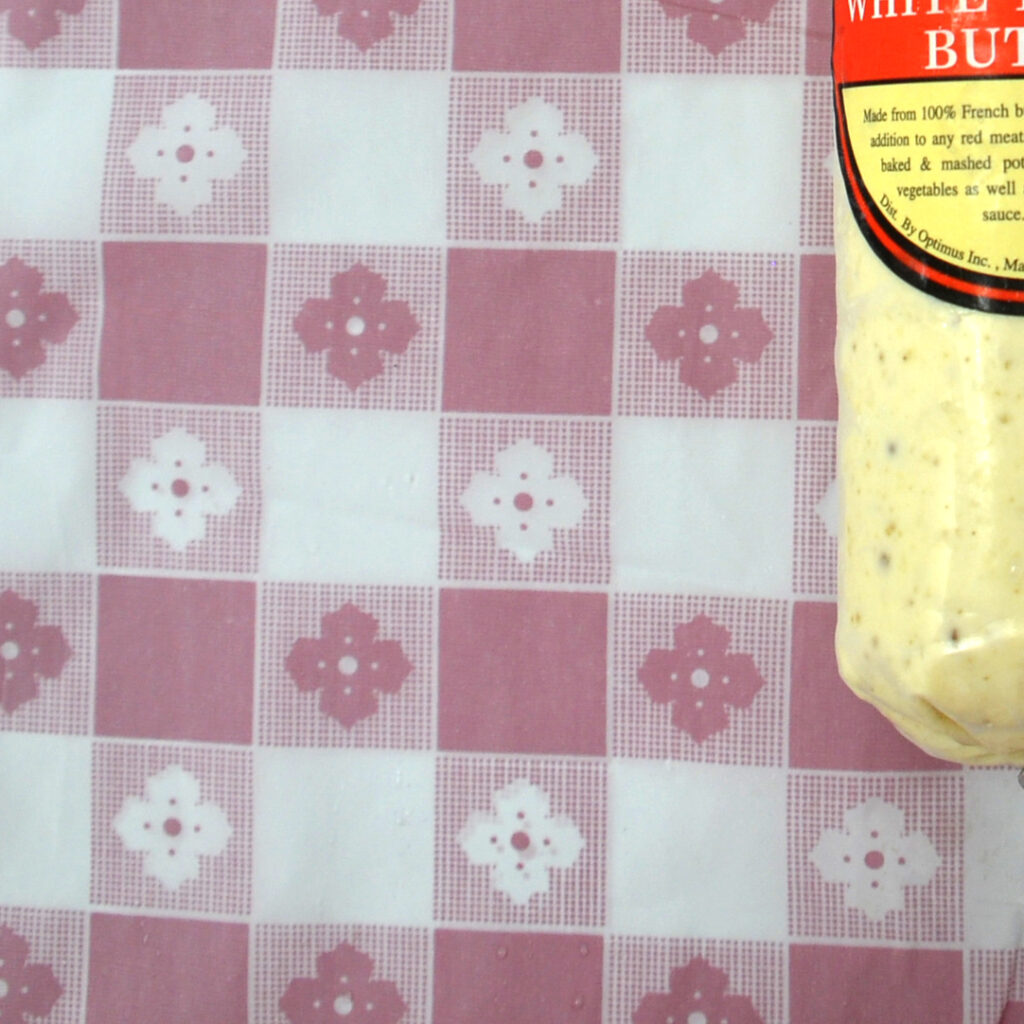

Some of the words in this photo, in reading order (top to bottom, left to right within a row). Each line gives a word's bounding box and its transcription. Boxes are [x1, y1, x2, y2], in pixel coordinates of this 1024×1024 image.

[863, 109, 887, 123] Made
[891, 108, 916, 122] from
[922, 105, 956, 120] 100%
[962, 104, 1009, 119] French
[870, 133, 910, 148] addition
[915, 133, 926, 145] to
[932, 132, 954, 148] any
[961, 130, 982, 145] red
[881, 157, 911, 172] baked
[921, 158, 931, 171] &
[941, 156, 992, 171] mashed
[897, 182, 958, 201] vegetables
[965, 184, 979, 196] as
[987, 180, 1015, 195] well
[982, 207, 1024, 222] sauce.
[879, 193, 898, 222] Dist.
[901, 217, 918, 237] By
[918, 229, 965, 261] Optimus
